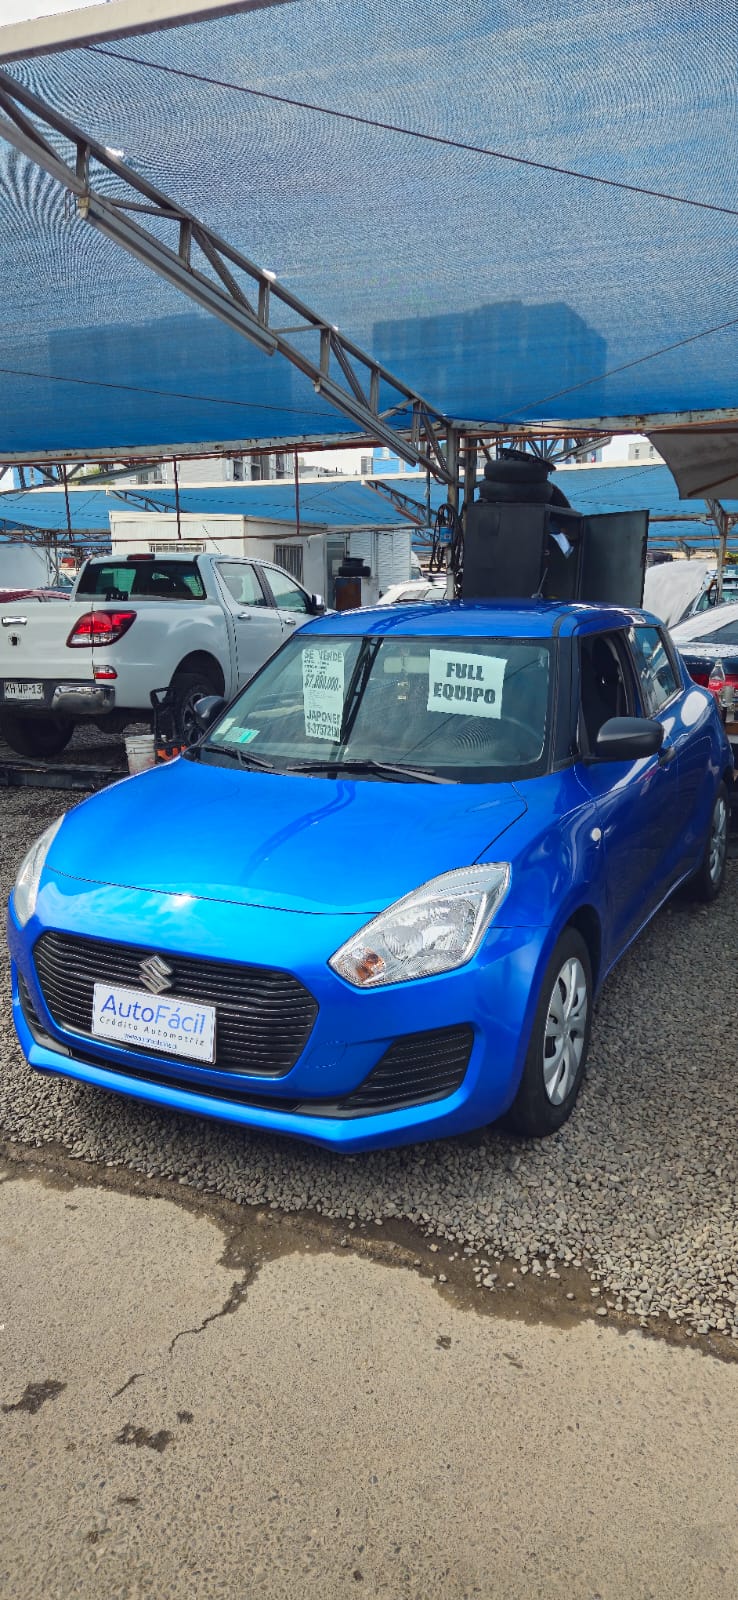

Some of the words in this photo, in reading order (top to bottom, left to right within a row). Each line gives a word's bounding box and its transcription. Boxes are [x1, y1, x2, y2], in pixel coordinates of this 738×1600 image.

[446, 662, 485, 681] FULL
[433, 682, 496, 704] EQUIPO
[100, 994, 207, 1035] AutoFácil
[143, 1026, 205, 1046] Automotriz
